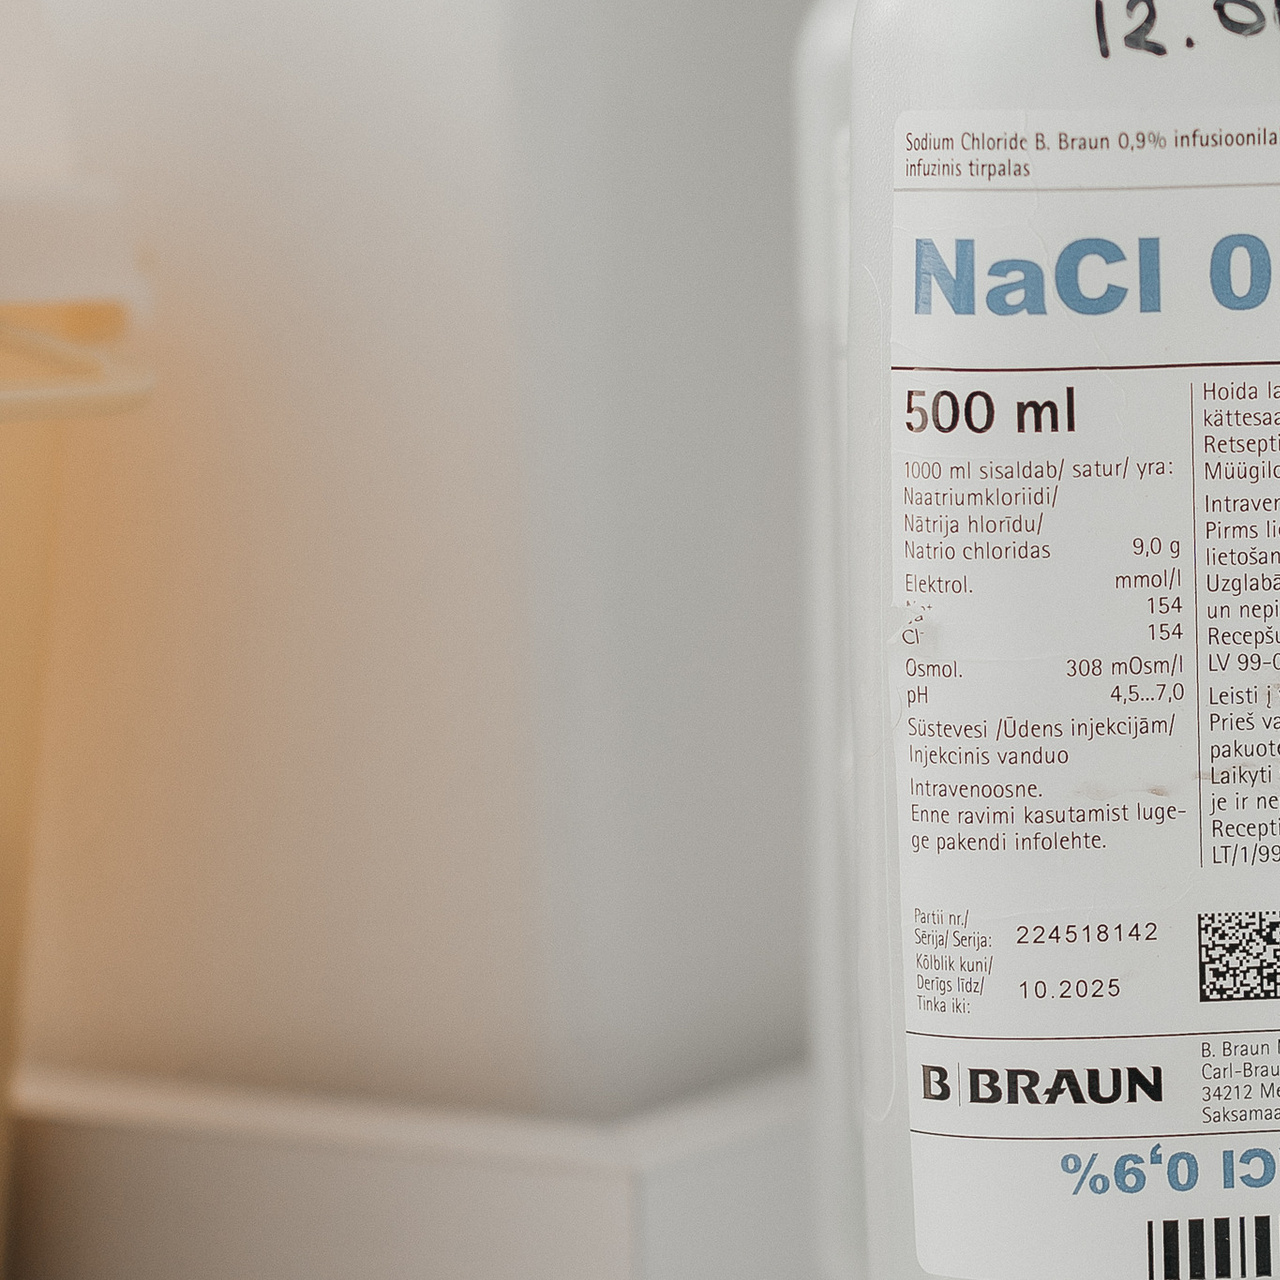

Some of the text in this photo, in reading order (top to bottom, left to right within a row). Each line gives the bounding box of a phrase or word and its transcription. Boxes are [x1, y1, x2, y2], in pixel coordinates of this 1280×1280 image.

[905, 132, 955, 152] Sodium
[960, 131, 1028, 152] Chloride
[1035, 131, 1051, 152] B.
[1058, 131, 1110, 151] Braun
[1117, 130, 1167, 153] 0,9%
[905, 157, 1031, 182] infuzinis tirpalas
[914, 236, 1162, 317] NaCl
[1203, 381, 1258, 401] Hoida
[905, 385, 1076, 435] 500 ml
[904, 455, 1173, 482] 1000 ml sisaldab/ satur/ yra:
[903, 484, 1059, 509] Naatriumkloriidi/
[904, 511, 1044, 539] Nātrija hlorīdu/
[1205, 520, 1259, 540] Pirms
[904, 536, 1180, 561] Natrio chloridas 9,0 g
[905, 566, 1181, 594] Elektrol. mmol/l
[1147, 595, 1183, 615] 154
[1207, 604, 1231, 620] un
[1148, 622, 1184, 641] 154
[905, 653, 1183, 679] Osmol. 308 mOsm/l
[1208, 652, 1231, 672] LV
[906, 682, 1185, 709] pH 4,5...7,0
[1209, 685, 1258, 706] Leisti
[907, 712, 1176, 742] Süstevesi /Ūdens injekcijām/
[1209, 711, 1256, 732] Prieš
[908, 744, 1069, 770] Injekcinis vanduo
[910, 777, 1043, 799] Intravenoosne.
[1210, 763, 1272, 789] Laikyti
[911, 801, 1187, 826] Enne ravimi kasutamist luge-
[1208, 792, 1228, 817] je
[1235, 791, 1249, 811] ir
[911, 830, 1107, 855] ge pakendi infolehte.
[913, 906, 971, 930] Partii nr./
[914, 927, 992, 952] Sērija/ Serija:
[1016, 921, 1158, 945] 224518142
[957, 954, 995, 977] kuni/
[916, 973, 986, 999] Derīgs līdz/
[1019, 978, 1121, 1000] 10.2025
[916, 994, 972, 1015] Tinka iki:
[1201, 1041, 1216, 1058] B.
[1222, 1040, 1270, 1057] Braun
[920, 1063, 1164, 1105] B BRAUN
[1201, 1083, 1253, 1103] 34212
[1060, 1142, 1200, 1196] 0,9%
